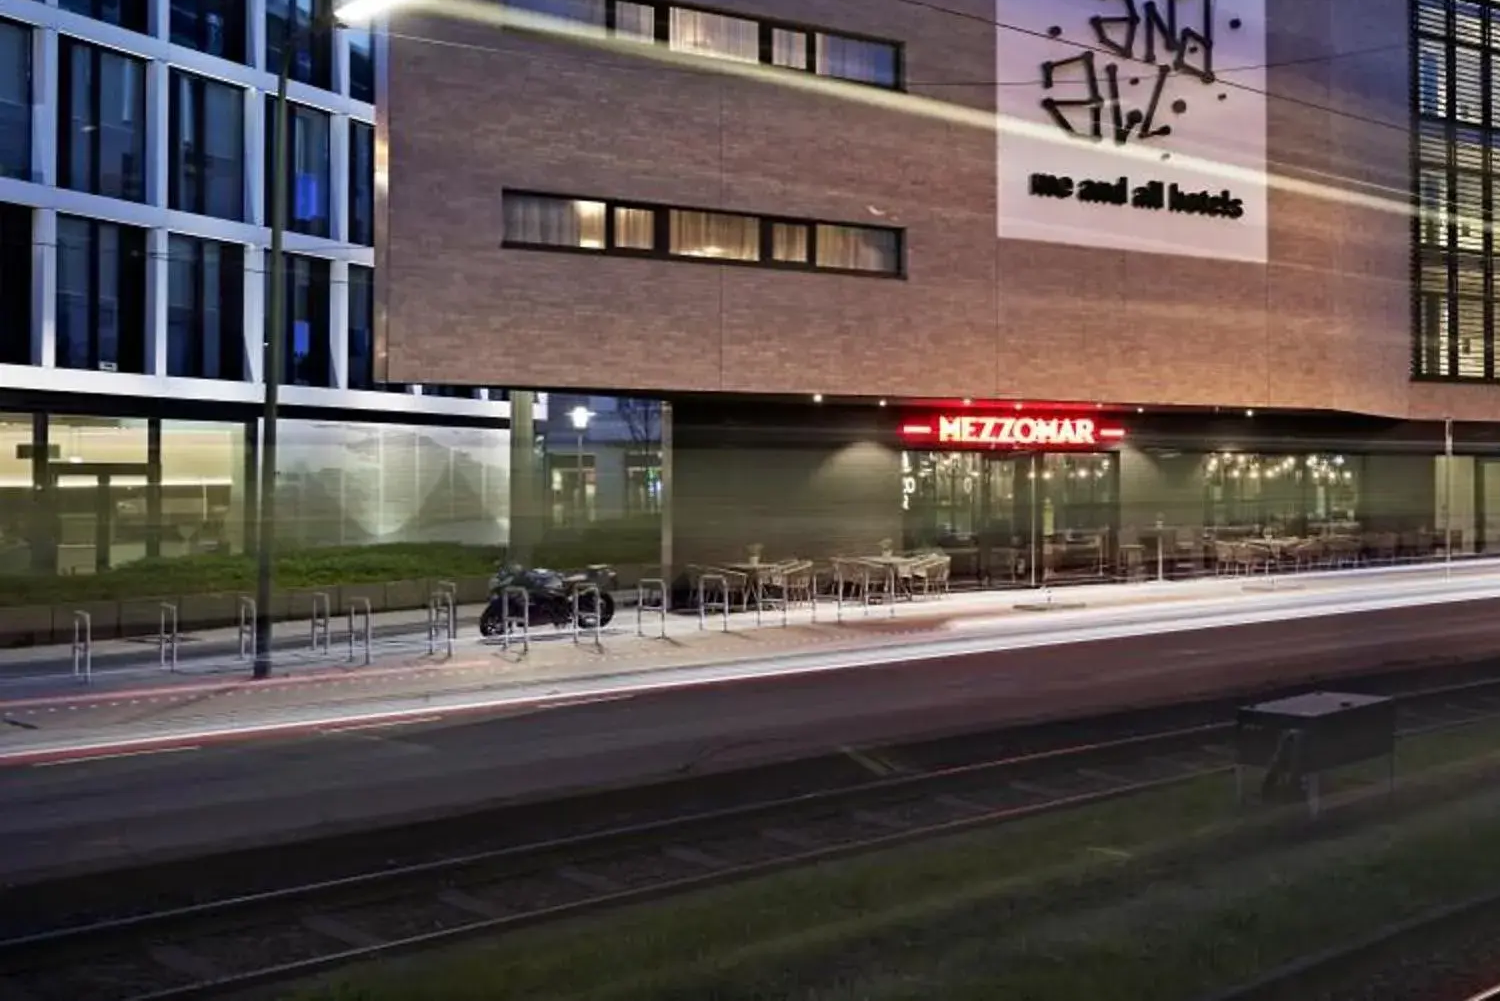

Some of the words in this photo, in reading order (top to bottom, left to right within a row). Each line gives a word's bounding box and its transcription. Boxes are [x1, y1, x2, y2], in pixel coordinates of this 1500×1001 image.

[1029, 173, 1074, 199] me
[1076, 176, 1128, 206] and
[1131, 180, 1165, 210] all
[1168, 183, 1244, 219] hotels
[939, 415, 1096, 444] MEZZOMAR
